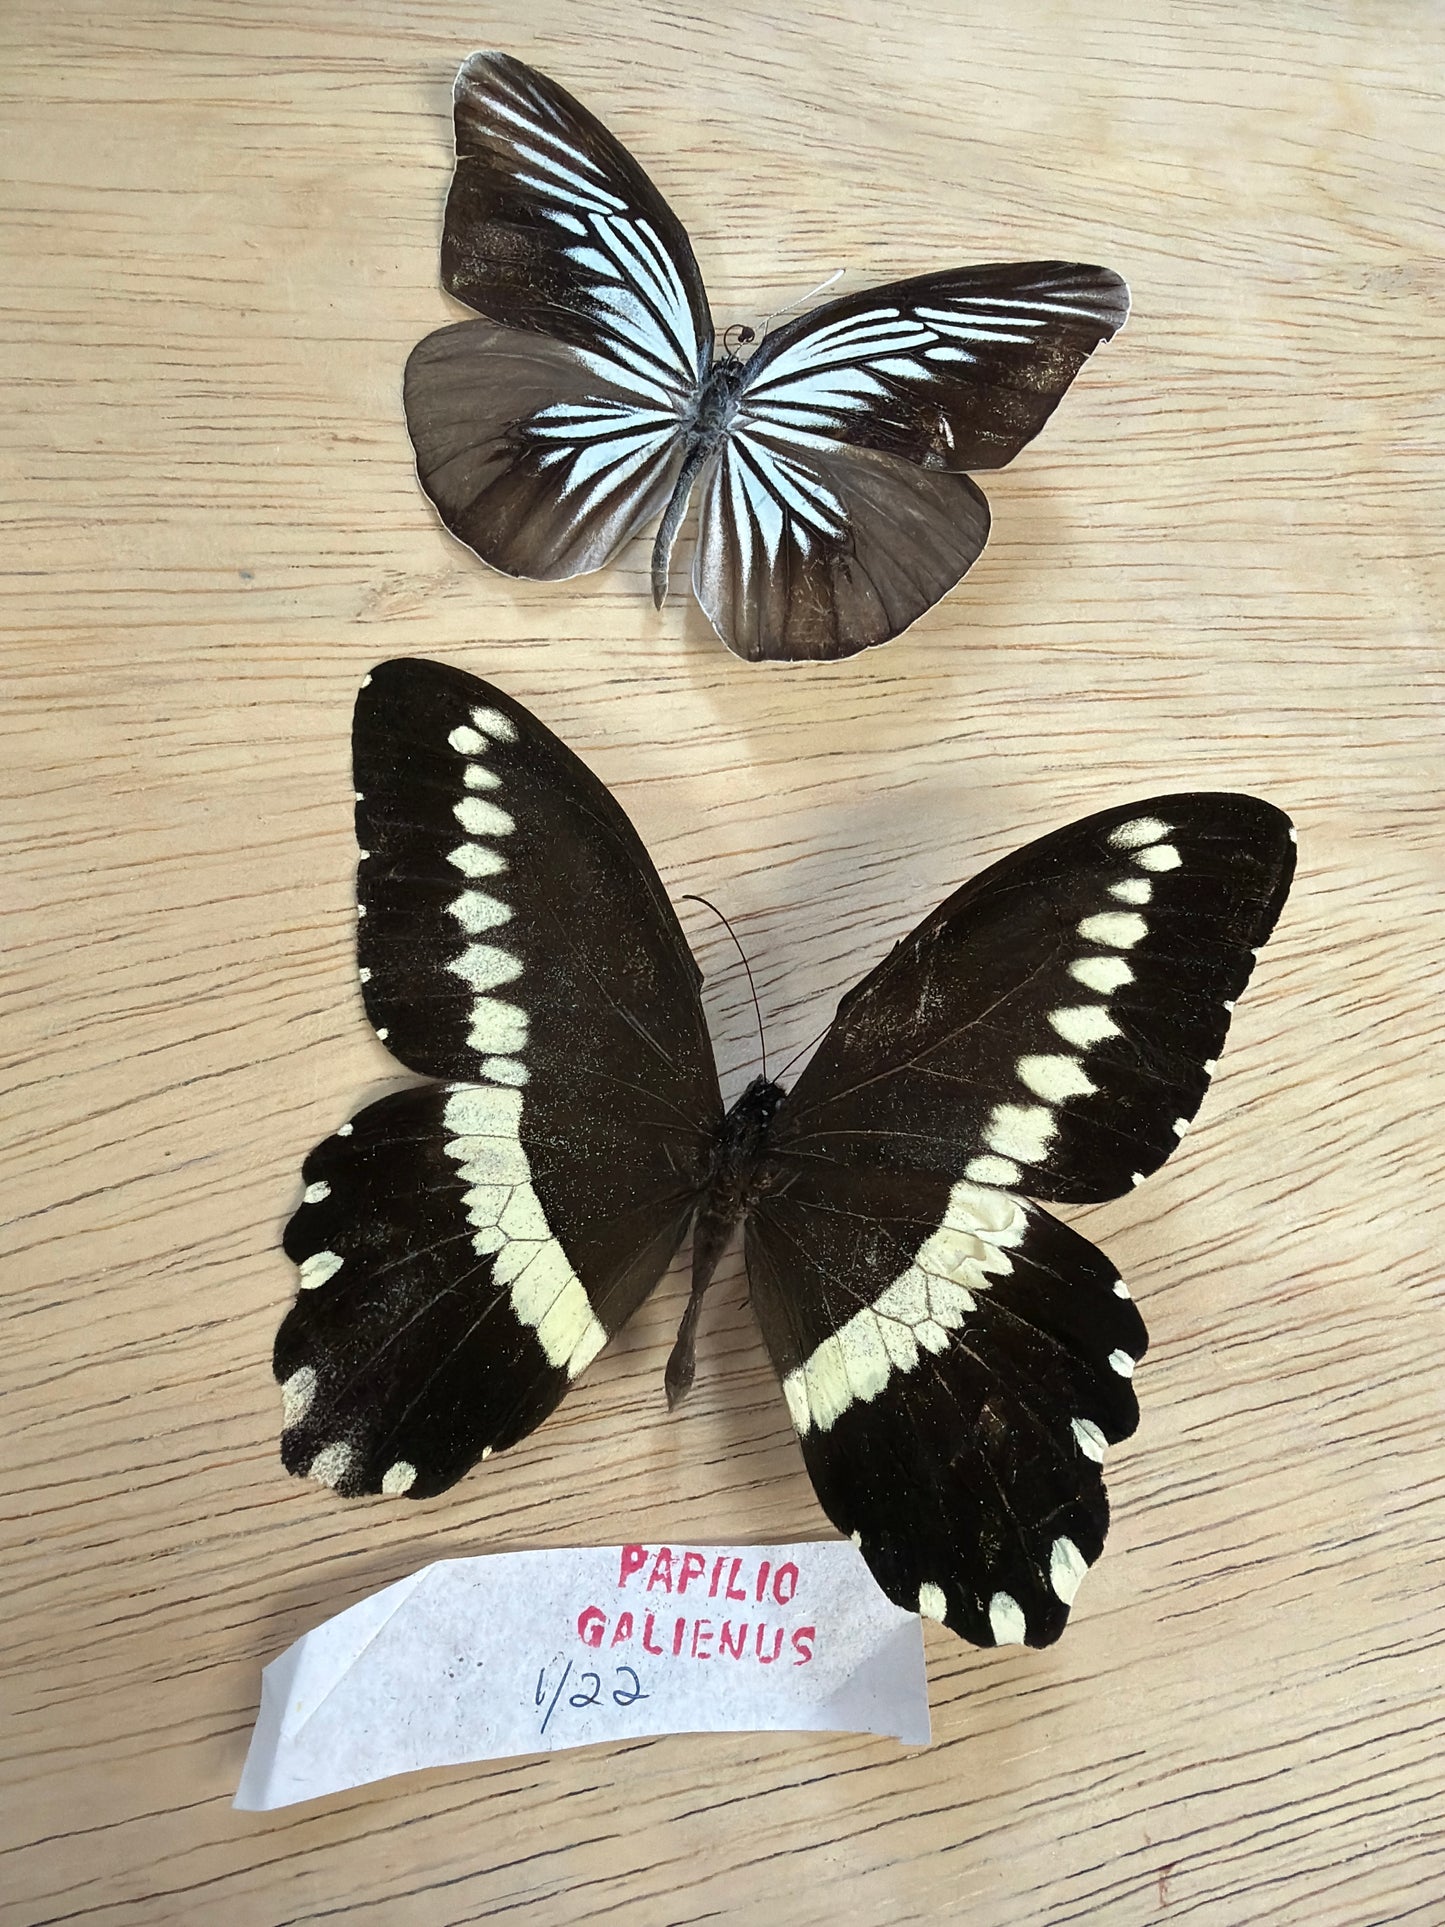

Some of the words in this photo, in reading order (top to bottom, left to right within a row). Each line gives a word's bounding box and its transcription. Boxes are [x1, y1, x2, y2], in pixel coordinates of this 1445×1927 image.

[618, 1543, 800, 1605] PAPILIO
[577, 1605, 817, 1666] GALIENUS
[534, 1660, 650, 1734] 1/22
